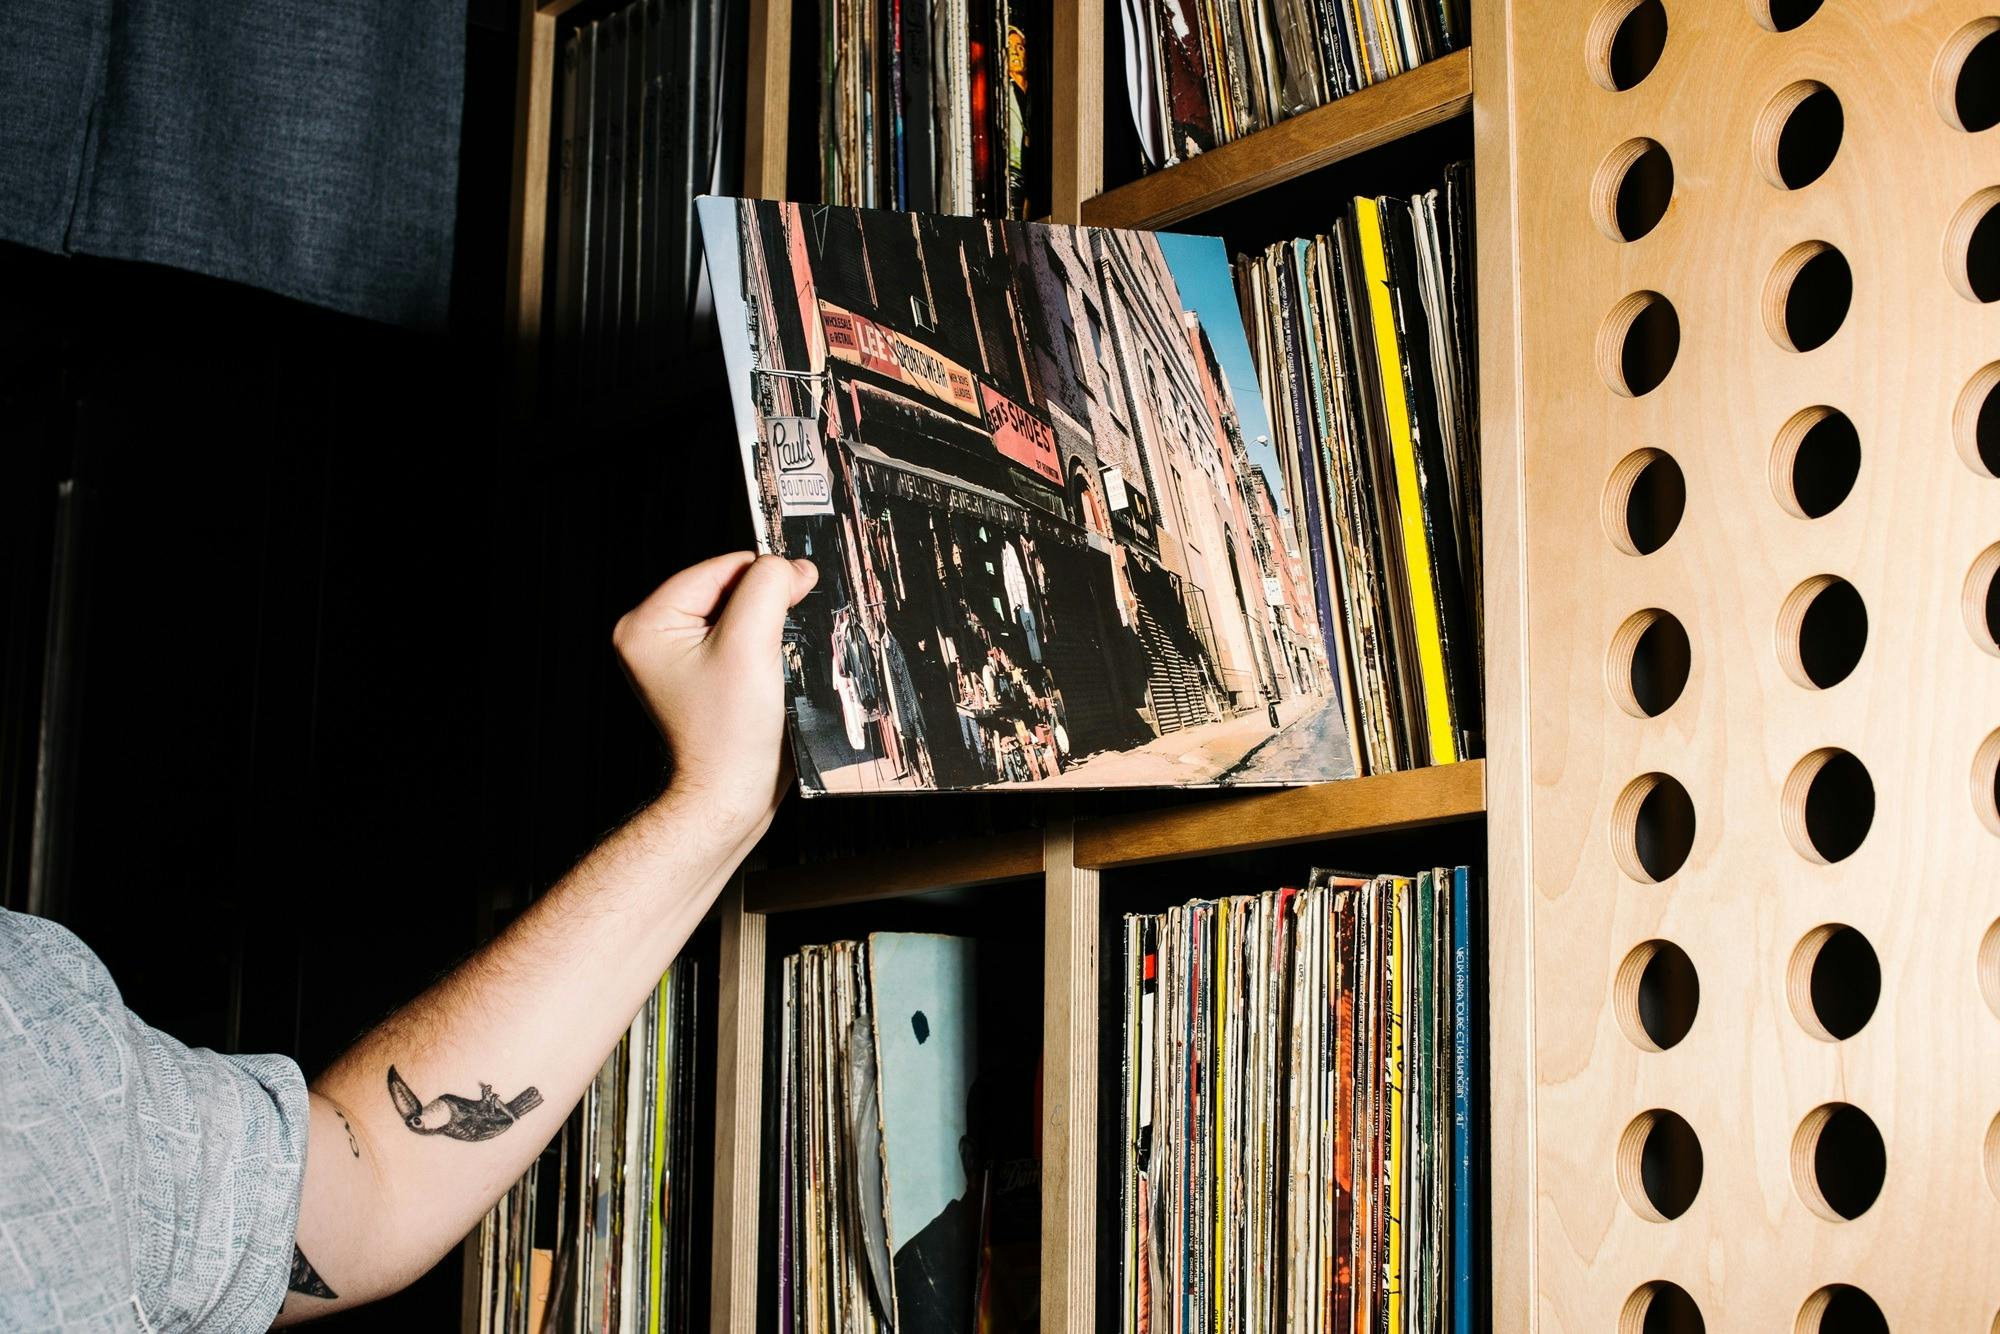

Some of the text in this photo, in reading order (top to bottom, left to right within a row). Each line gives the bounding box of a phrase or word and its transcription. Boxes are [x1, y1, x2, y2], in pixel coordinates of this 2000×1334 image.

[855, 321, 949, 389] LEE'S SPORTSWEAR
[1291, 383, 1300, 414] GENTLEMAN
[1008, 401, 1051, 453] SHOES
[772, 420, 816, 473] Paul's
[780, 479, 826, 497] BOUTIQUE
[1456, 946, 1465, 973] VIEUX
[1456, 974, 1465, 1000] FARKA
[1456, 1001, 1466, 1031] TOURÉ
[1456, 1031, 1465, 1044] ET
[1456, 1045, 1465, 1098] KHRUANGBIN
